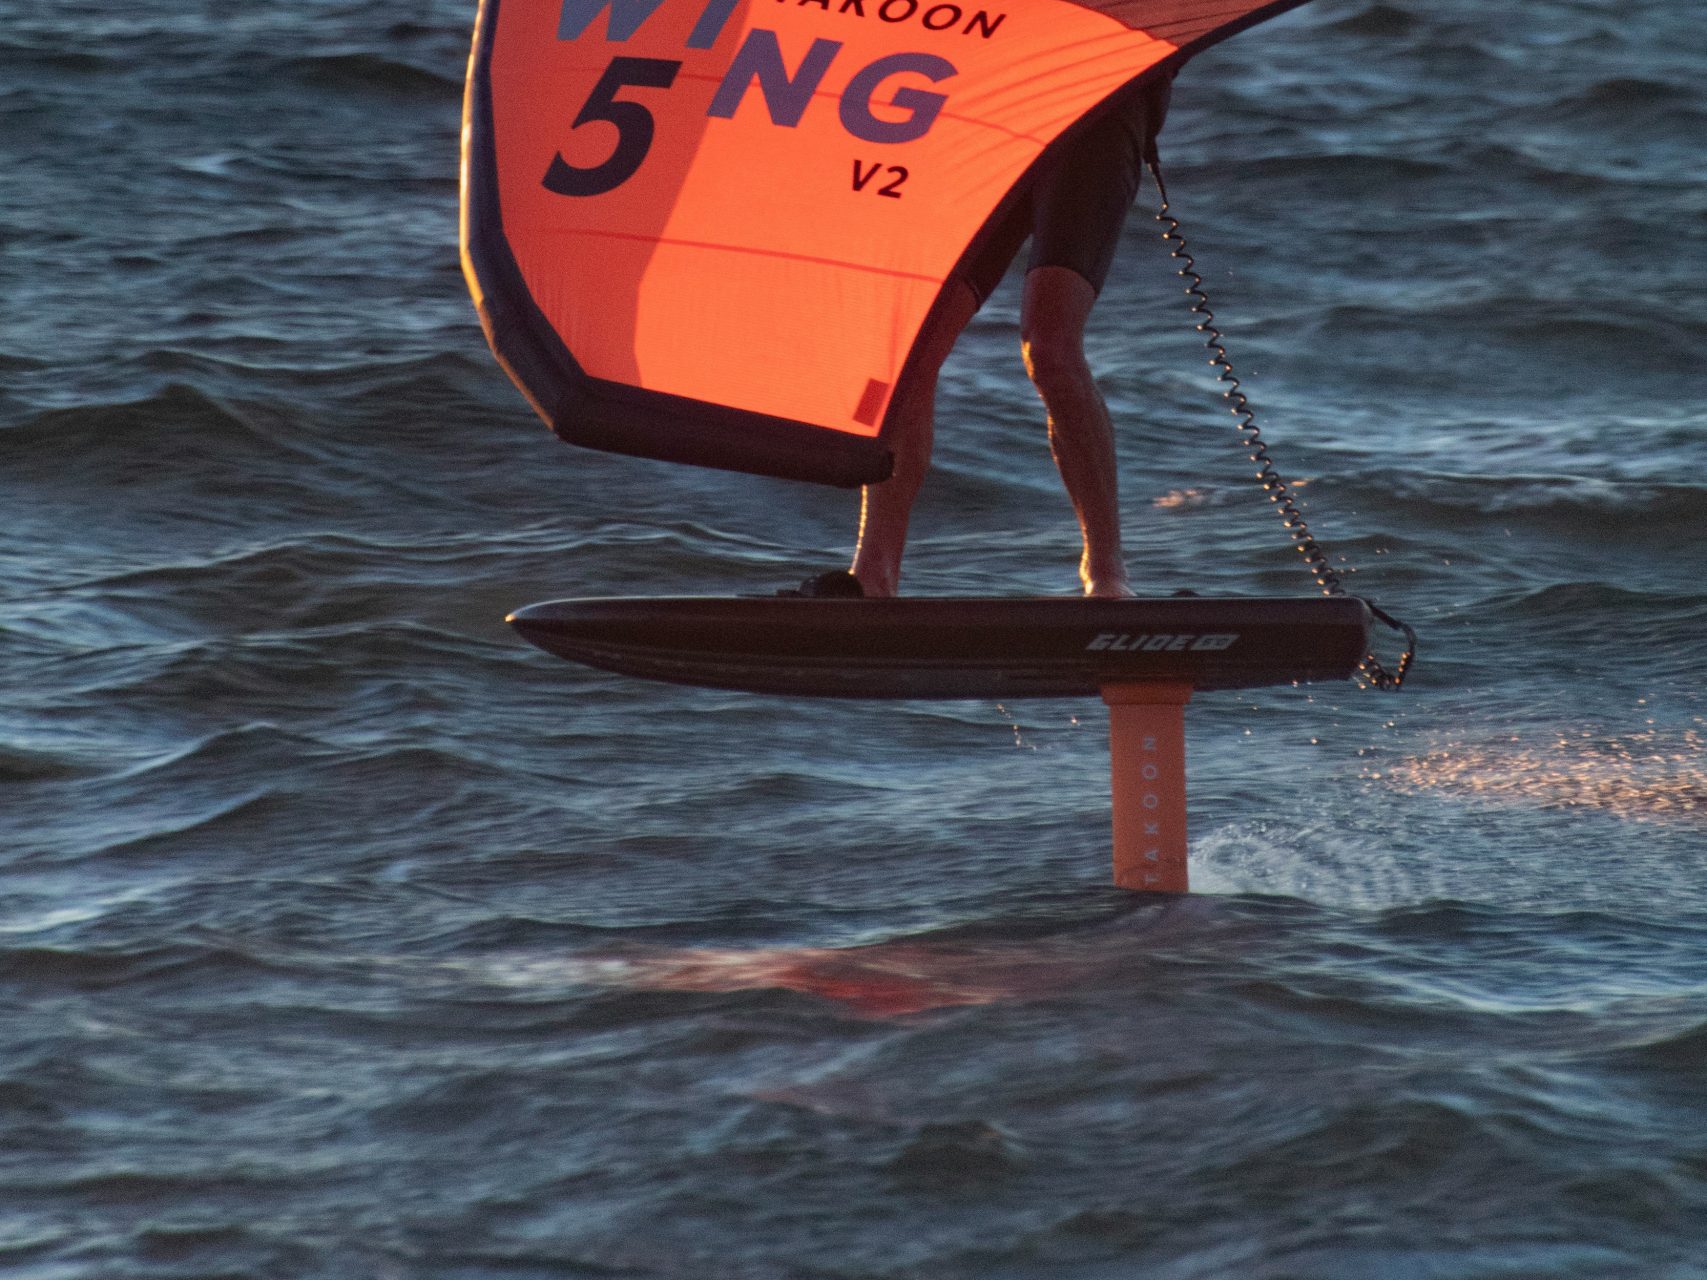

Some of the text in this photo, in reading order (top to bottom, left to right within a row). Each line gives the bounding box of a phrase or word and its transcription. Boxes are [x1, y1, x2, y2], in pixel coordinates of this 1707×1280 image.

[541, 56, 683, 197] 5
[706, 27, 959, 144] NG
[851, 159, 909, 199] V2
[1086, 633, 1195, 651] GLIDE
[1141, 734, 1160, 884] TAKOON
